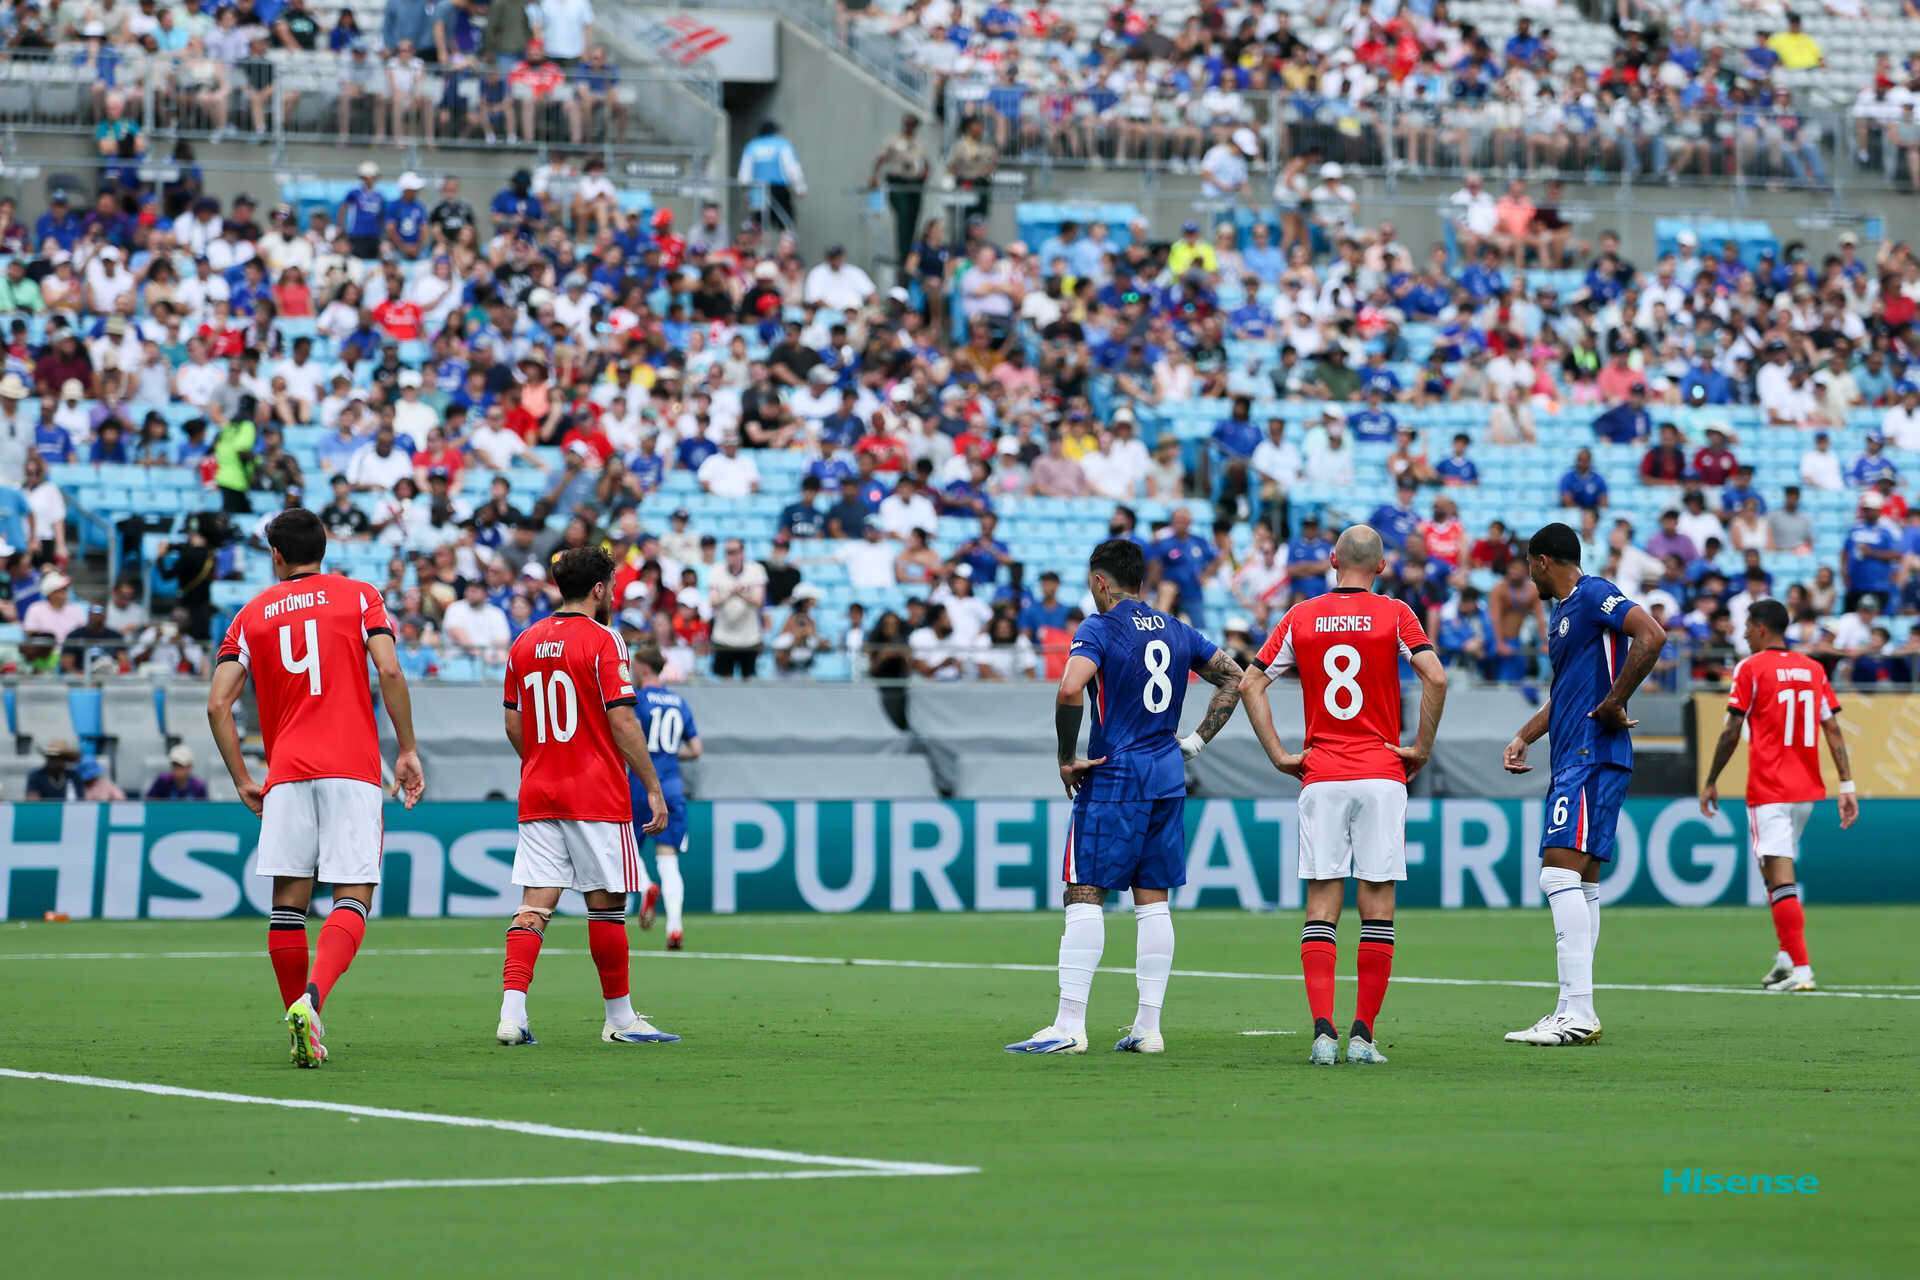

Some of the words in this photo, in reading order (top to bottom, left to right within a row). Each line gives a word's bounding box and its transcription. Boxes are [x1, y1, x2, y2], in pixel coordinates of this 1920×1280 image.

[264, 593, 315, 619] ANTÓNIO
[317, 590, 330, 605] S.
[1131, 615, 1166, 631] ENZO
[1315, 615, 1372, 633] AURSNES
[279, 619, 322, 696] 4
[1143, 640, 1173, 714] 8
[1323, 644, 1364, 721] 8
[523, 670, 578, 744] 10
[647, 706, 684, 755] 10
[1778, 688, 1815, 748] 11
[1552, 796, 1569, 826] 6
[0, 802, 633, 917] Hisns
